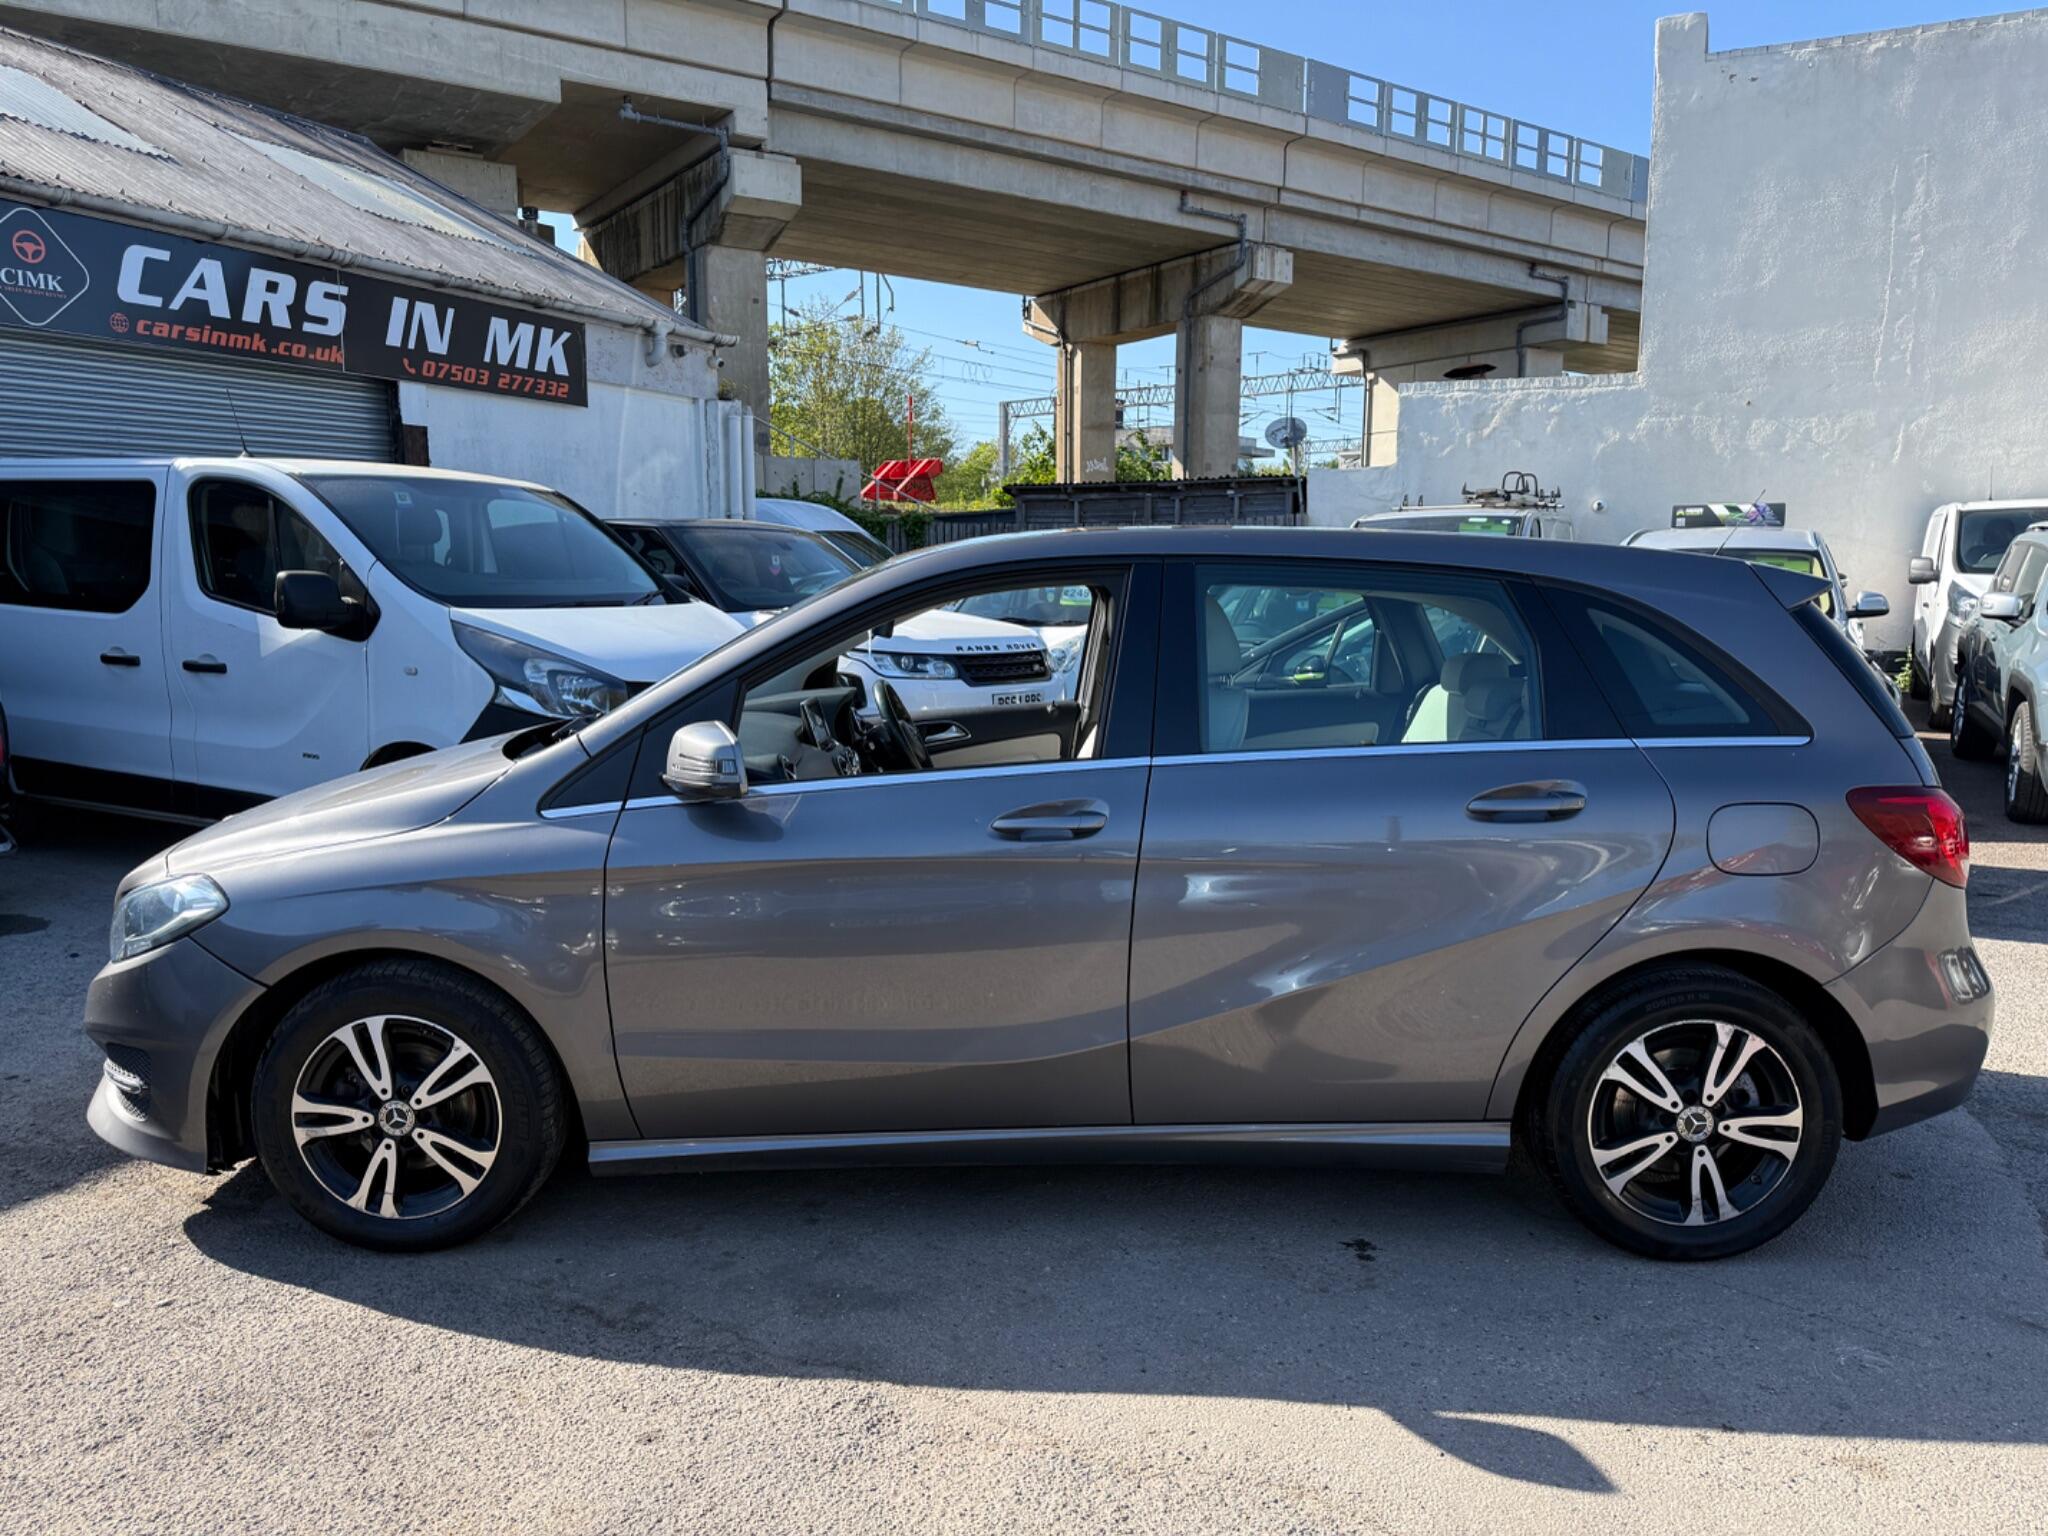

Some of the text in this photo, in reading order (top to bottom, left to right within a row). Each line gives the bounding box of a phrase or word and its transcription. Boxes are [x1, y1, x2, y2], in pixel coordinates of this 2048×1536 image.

[0, 267, 64, 292] CIMK
[117, 244, 572, 376] CARS IN MK
[136, 319, 344, 364] carsinmk.co.uk
[422, 360, 569, 398] 07503 277332
[955, 644, 1000, 652] RANGE
